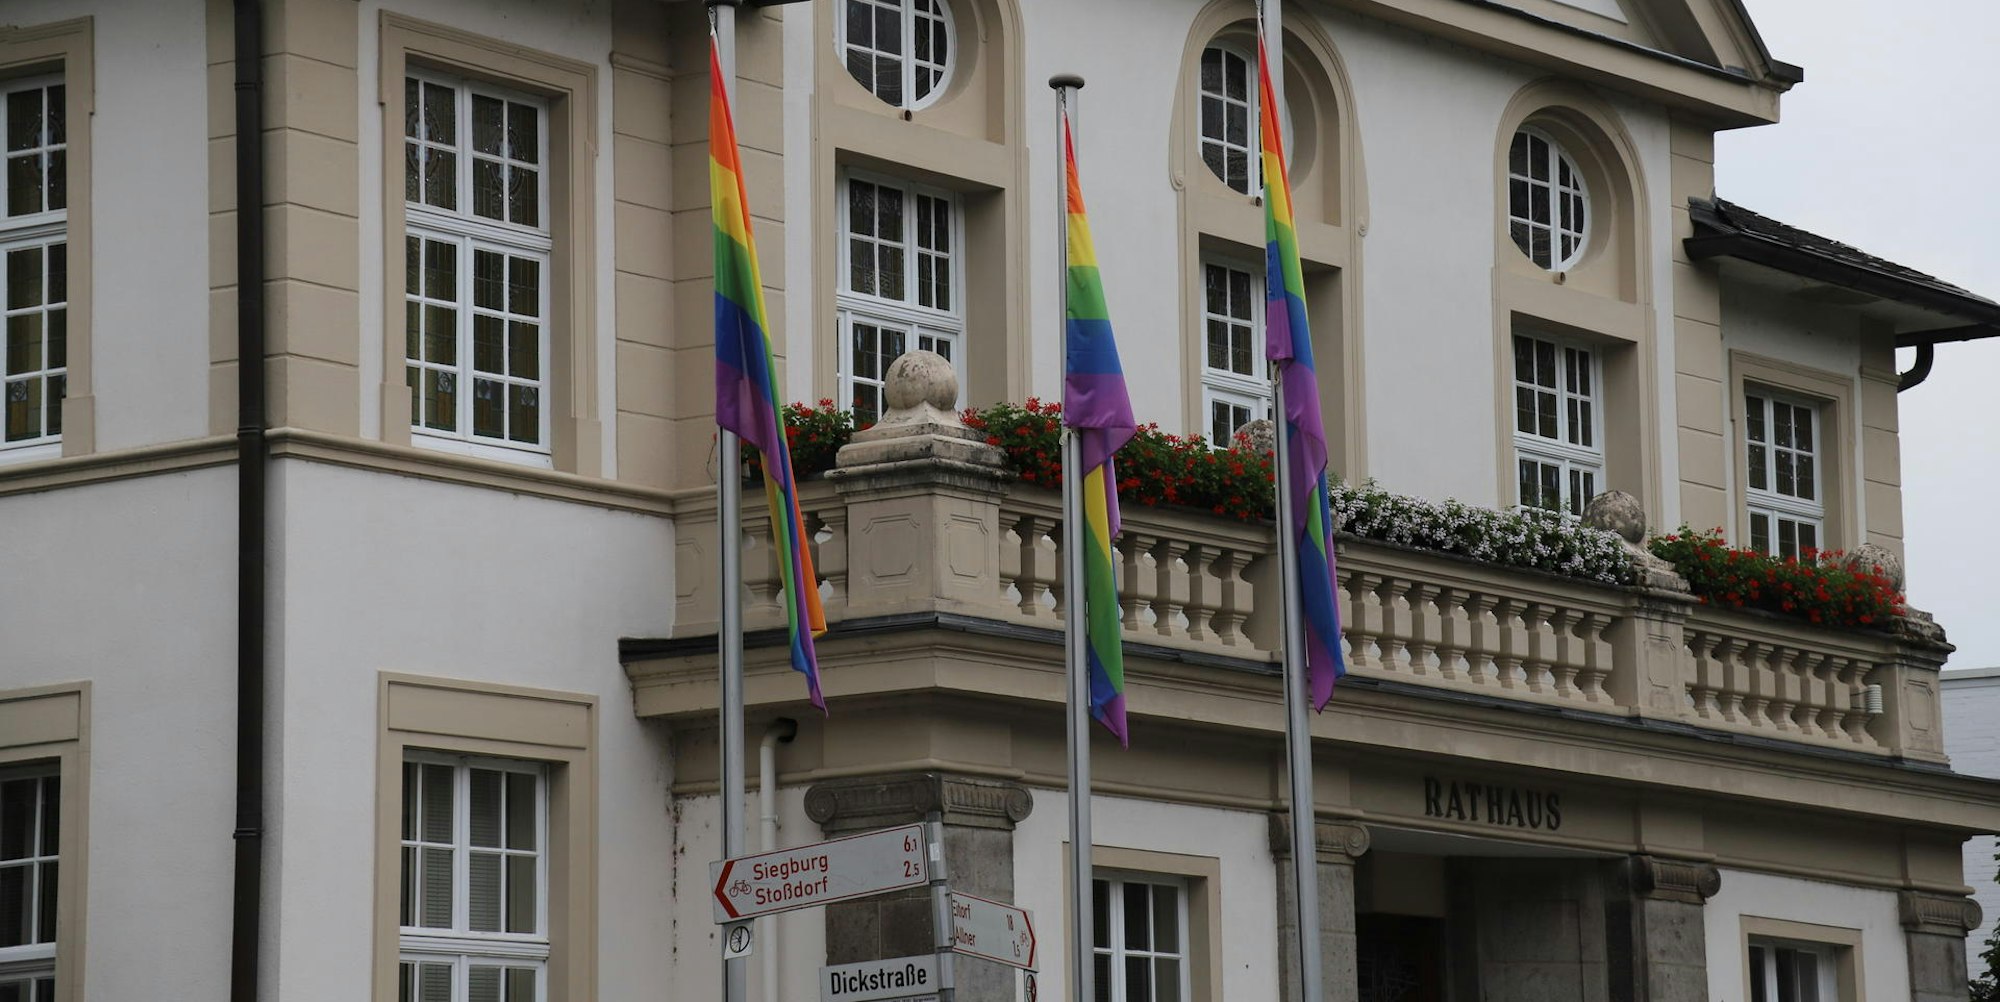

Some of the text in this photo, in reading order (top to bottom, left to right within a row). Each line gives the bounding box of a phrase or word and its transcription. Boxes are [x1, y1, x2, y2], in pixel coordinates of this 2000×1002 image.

[1425, 777, 1561, 830] RATHAUS
[753, 835, 918, 881] Siegburg 6.1
[755, 860, 920, 905] Stoßdorf 2.5
[831, 964, 928, 996] Dickstraße
